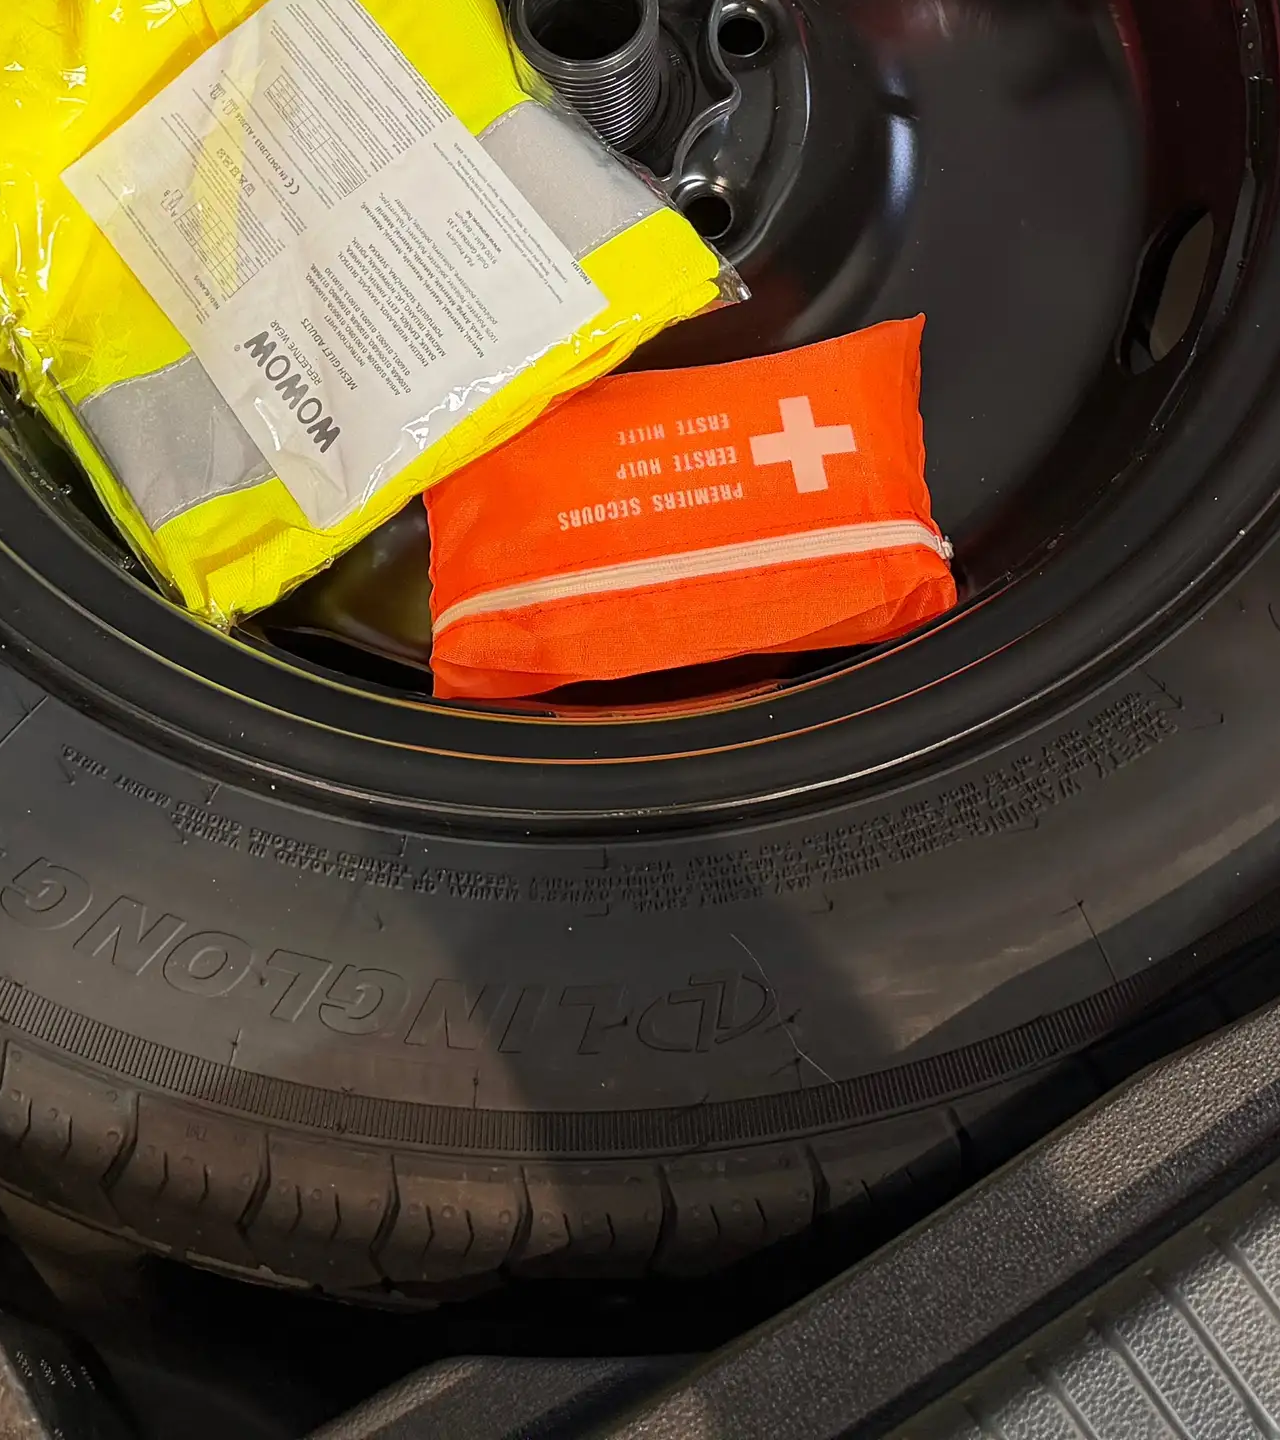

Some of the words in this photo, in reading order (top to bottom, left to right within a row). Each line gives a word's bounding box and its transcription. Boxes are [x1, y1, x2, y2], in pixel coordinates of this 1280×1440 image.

[277, 169, 288, 181] EN
[335, 250, 359, 278] DEUTSCH,
[366, 243, 389, 269] SVENSKA
[474, 252, 489, 269] Oude
[355, 275, 382, 305] FRANÇAIS,
[268, 318, 291, 343] WEAR
[299, 316, 326, 348] ADULTS
[322, 313, 339, 332] SHEET
[395, 311, 421, 341] ESPAÑOL,
[483, 325, 499, 343] 100%
[335, 329, 366, 367] INSTRUCTION
[406, 339, 430, 367] ENGLISH,
[416, 337, 437, 361] DANSK,
[422, 328, 447, 357] MAGYAR,
[286, 341, 322, 386] REFLECTIVE
[320, 344, 341, 369] GILET
[241, 327, 346, 454] WOWOW
[336, 365, 358, 391] MESH
[383, 376, 401, 396] Article
[616, 422, 665, 446] HILFE
[676, 413, 730, 437] ERSTE
[616, 456, 662, 479] HULP
[673, 446, 738, 473] EERSTE
[652, 481, 744, 514] PREMIERS
[556, 495, 643, 532] SECOURS
[0, 858, 611, 1055] LINGLONG
